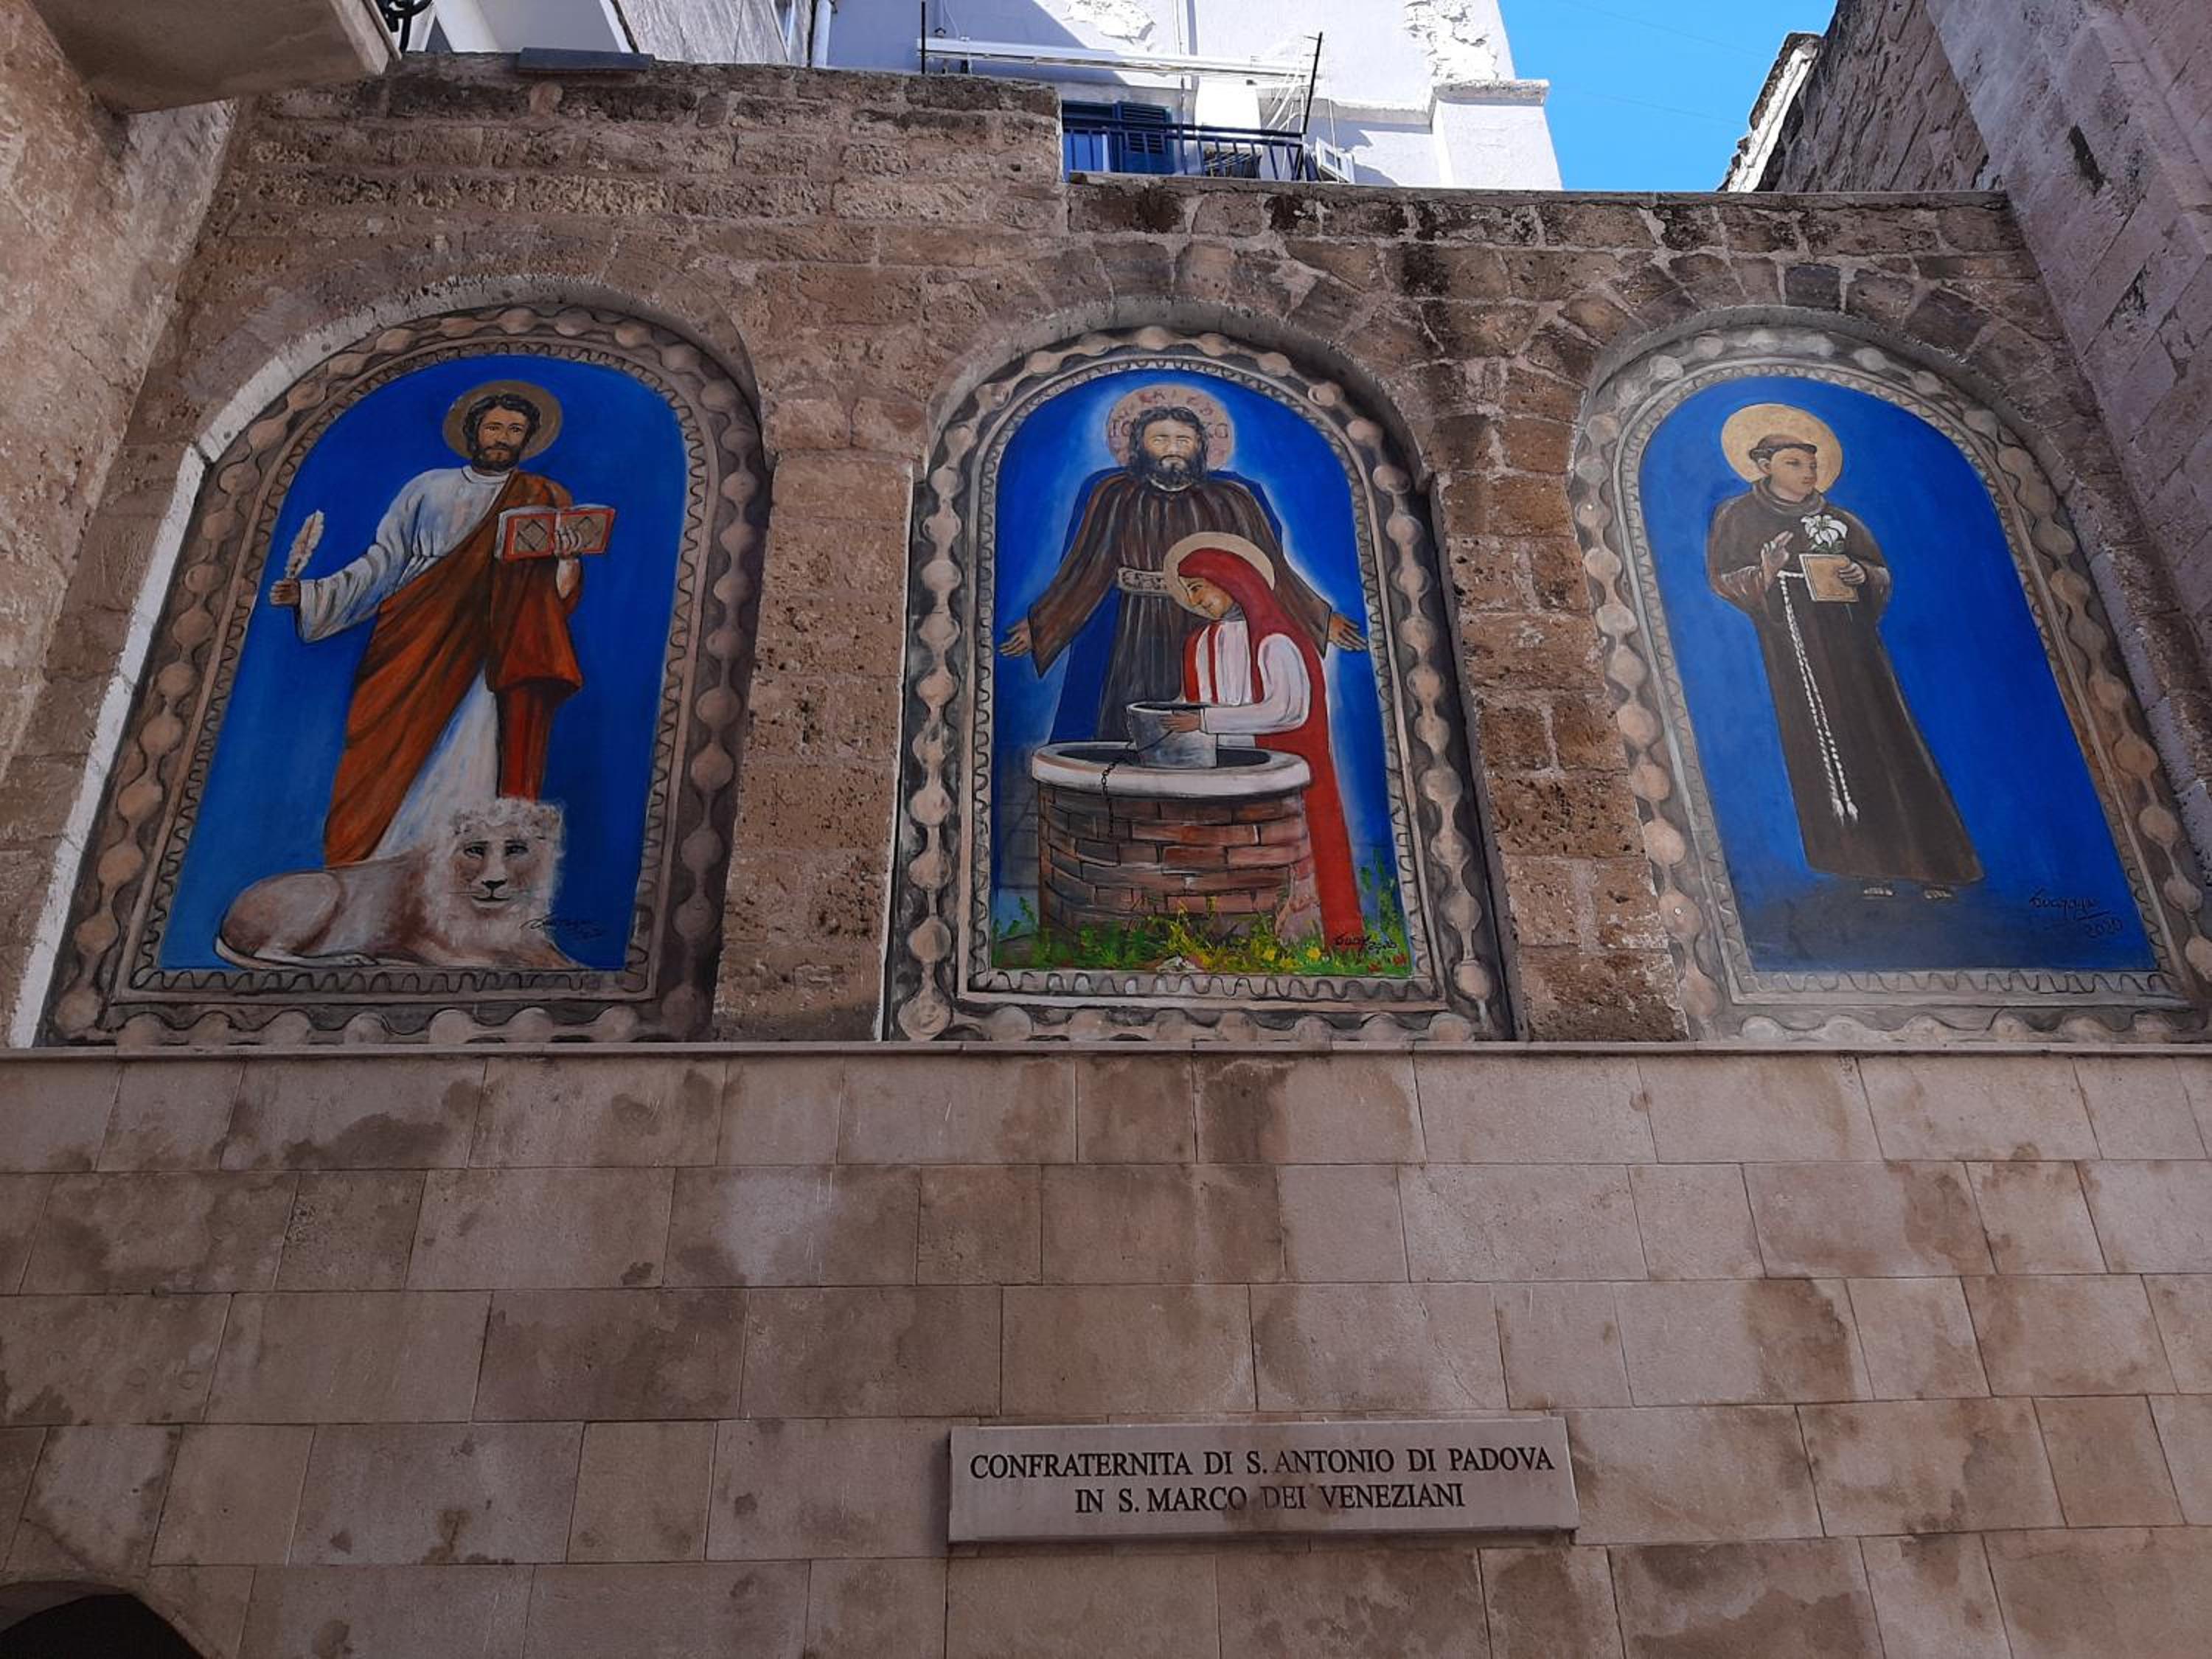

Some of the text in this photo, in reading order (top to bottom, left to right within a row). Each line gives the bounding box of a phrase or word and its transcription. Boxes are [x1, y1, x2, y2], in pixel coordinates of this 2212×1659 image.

[970, 1446, 1555, 1479] CONFRATERNITA DI S. ANTONIO DI PADOVA
[1074, 1483, 1465, 1514] IN S. MARCO DEI VENEZIANI
